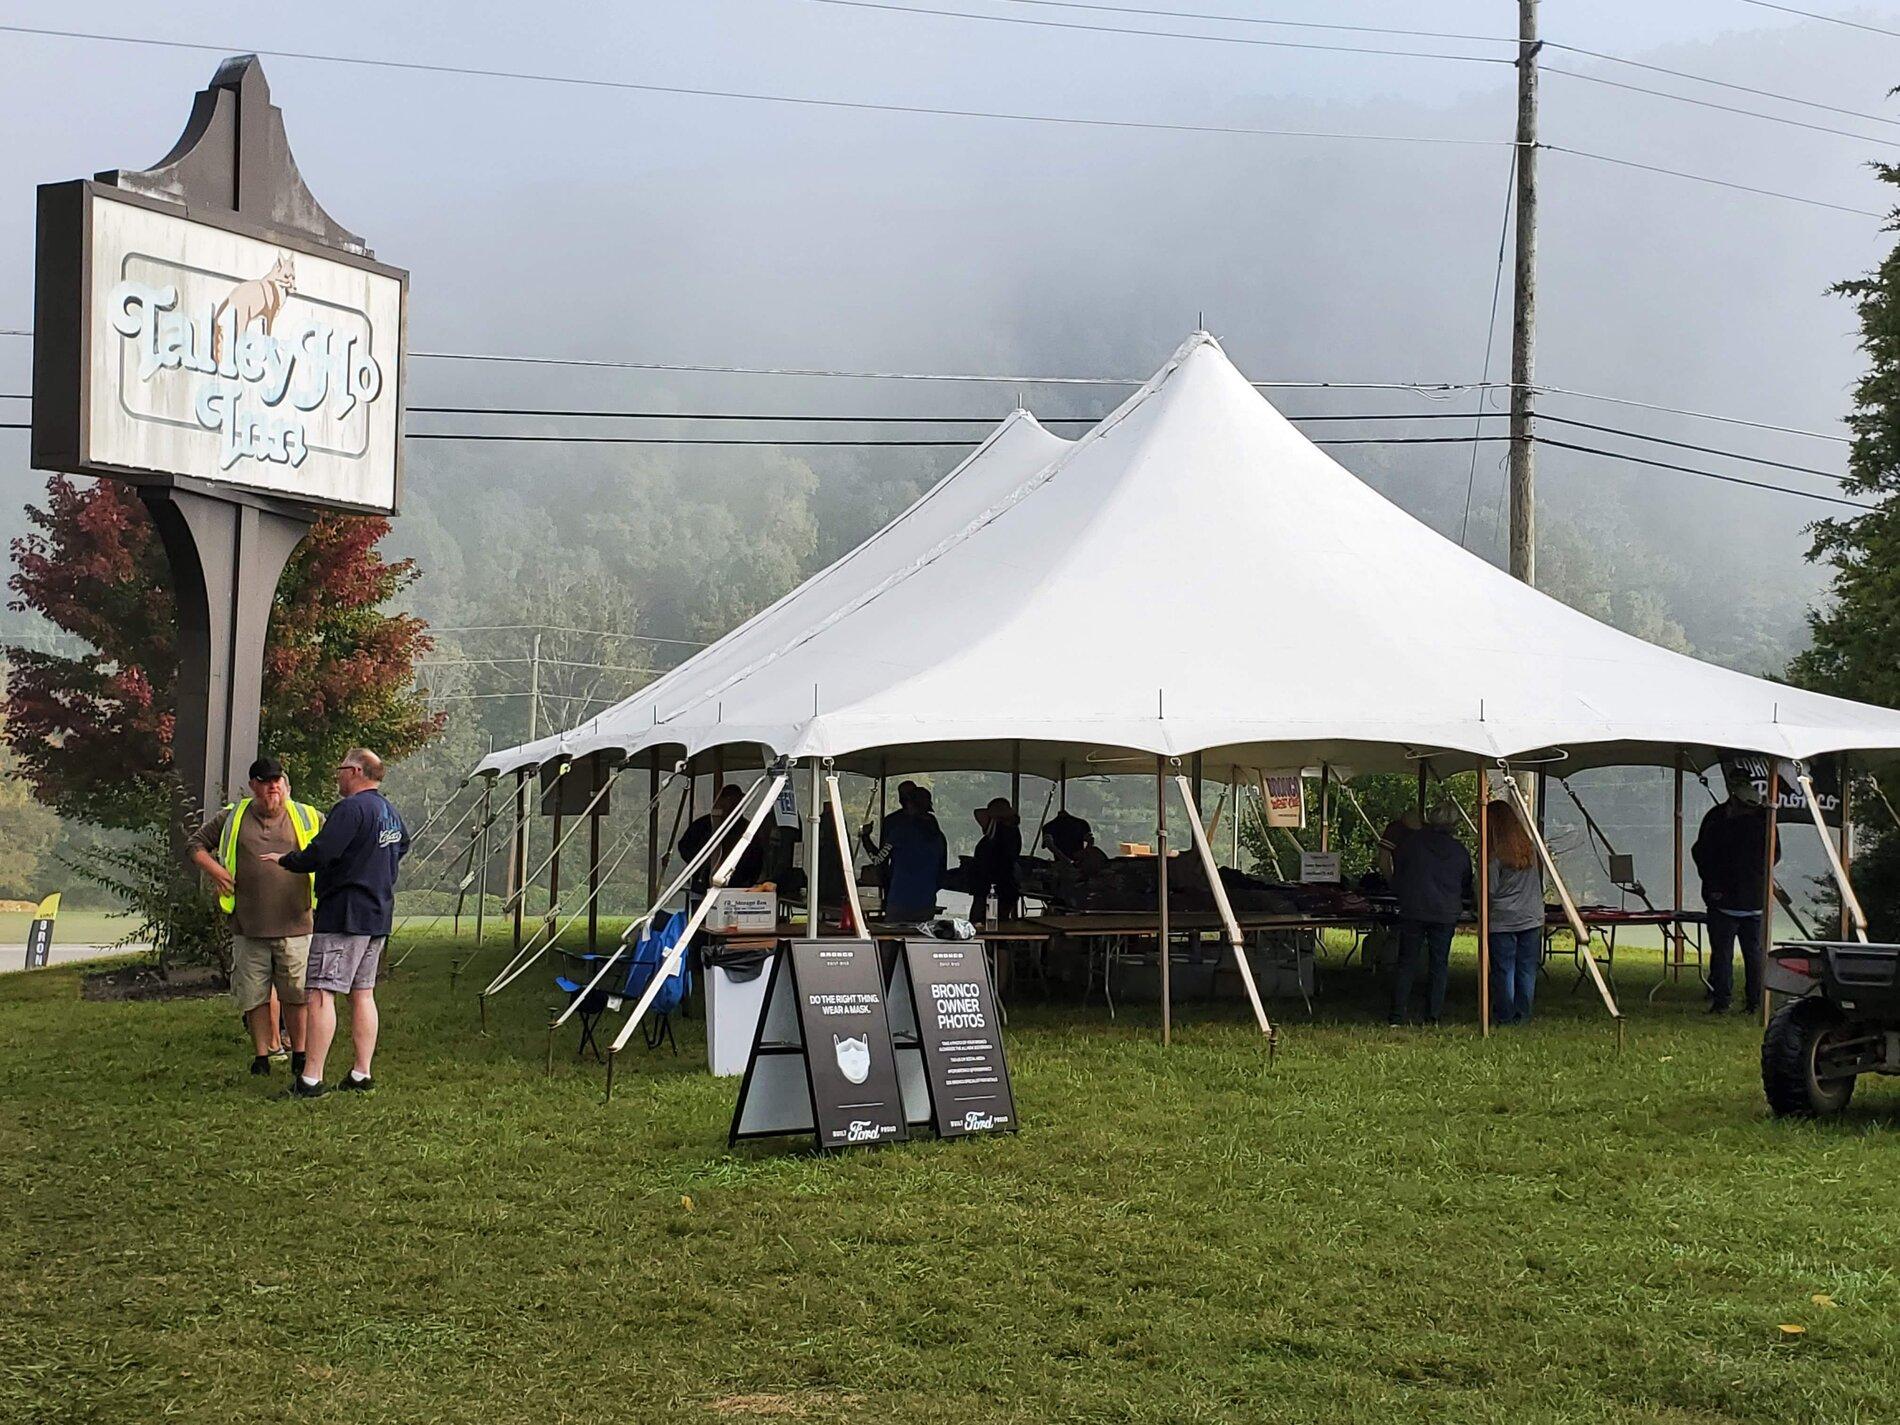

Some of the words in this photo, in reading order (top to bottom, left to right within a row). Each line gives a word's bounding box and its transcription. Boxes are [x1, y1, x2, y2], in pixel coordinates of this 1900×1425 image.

[110, 281, 296, 408] Talley
[195, 379, 308, 470] Inn
[931, 983, 980, 998] BRONCO
[809, 995, 821, 1004] DO
[821, 995, 835, 1004] THE
[835, 994, 857, 1003] RIGHT
[937, 998, 980, 1013] OWNER
[822, 1005, 843, 1014] WEAR
[844, 1006, 850, 1014] A
[938, 1013, 985, 1029] PHOTOS
[964, 1111, 994, 1131] Ford
[848, 1121, 880, 1141] Ford
